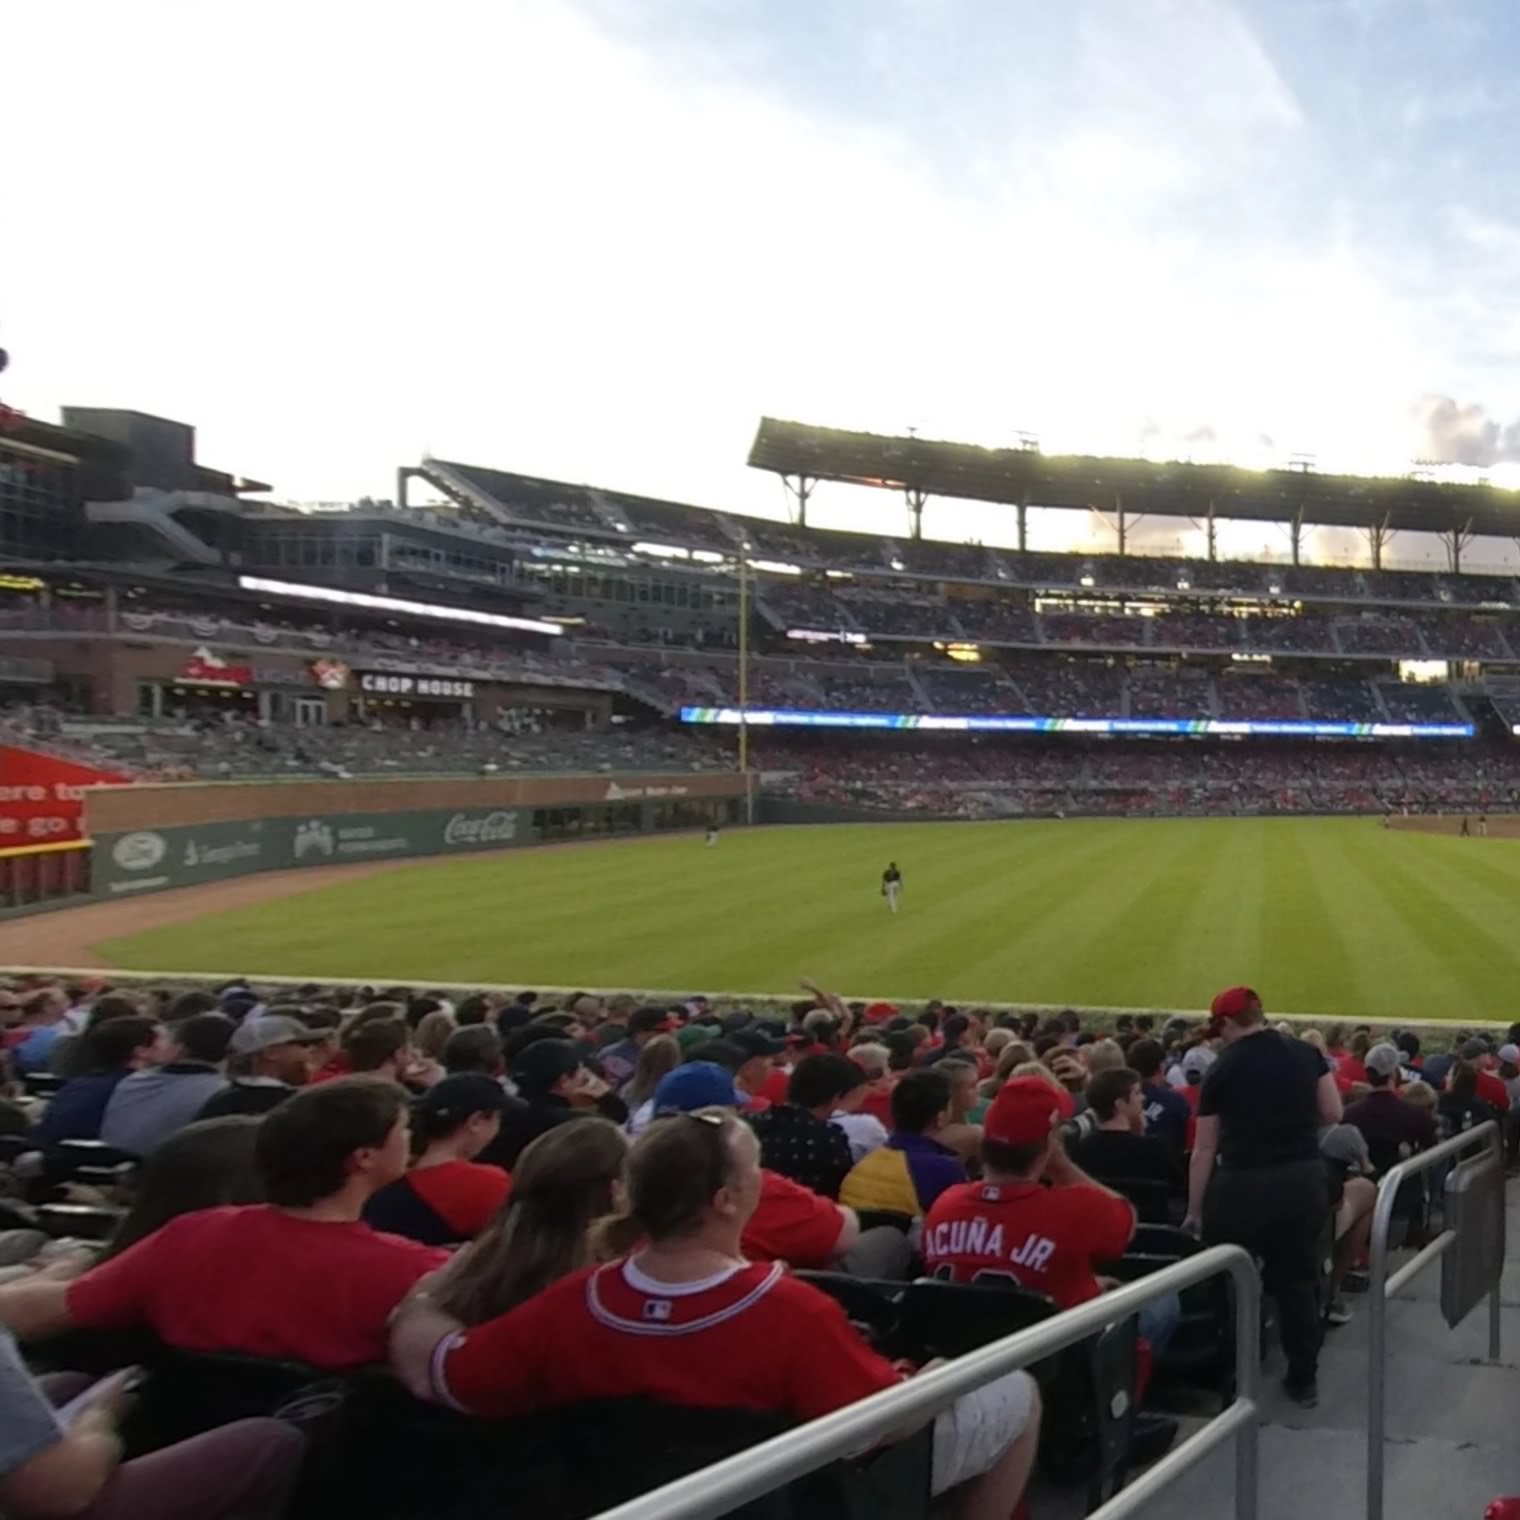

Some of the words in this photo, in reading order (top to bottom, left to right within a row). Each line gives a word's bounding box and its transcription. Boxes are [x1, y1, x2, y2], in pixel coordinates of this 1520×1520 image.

[361, 674, 412, 693] CHOP
[417, 681, 474, 698] HOUSE
[926, 1216, 1004, 1257] ACUÑA
[1009, 1233, 1056, 1273] JR.
